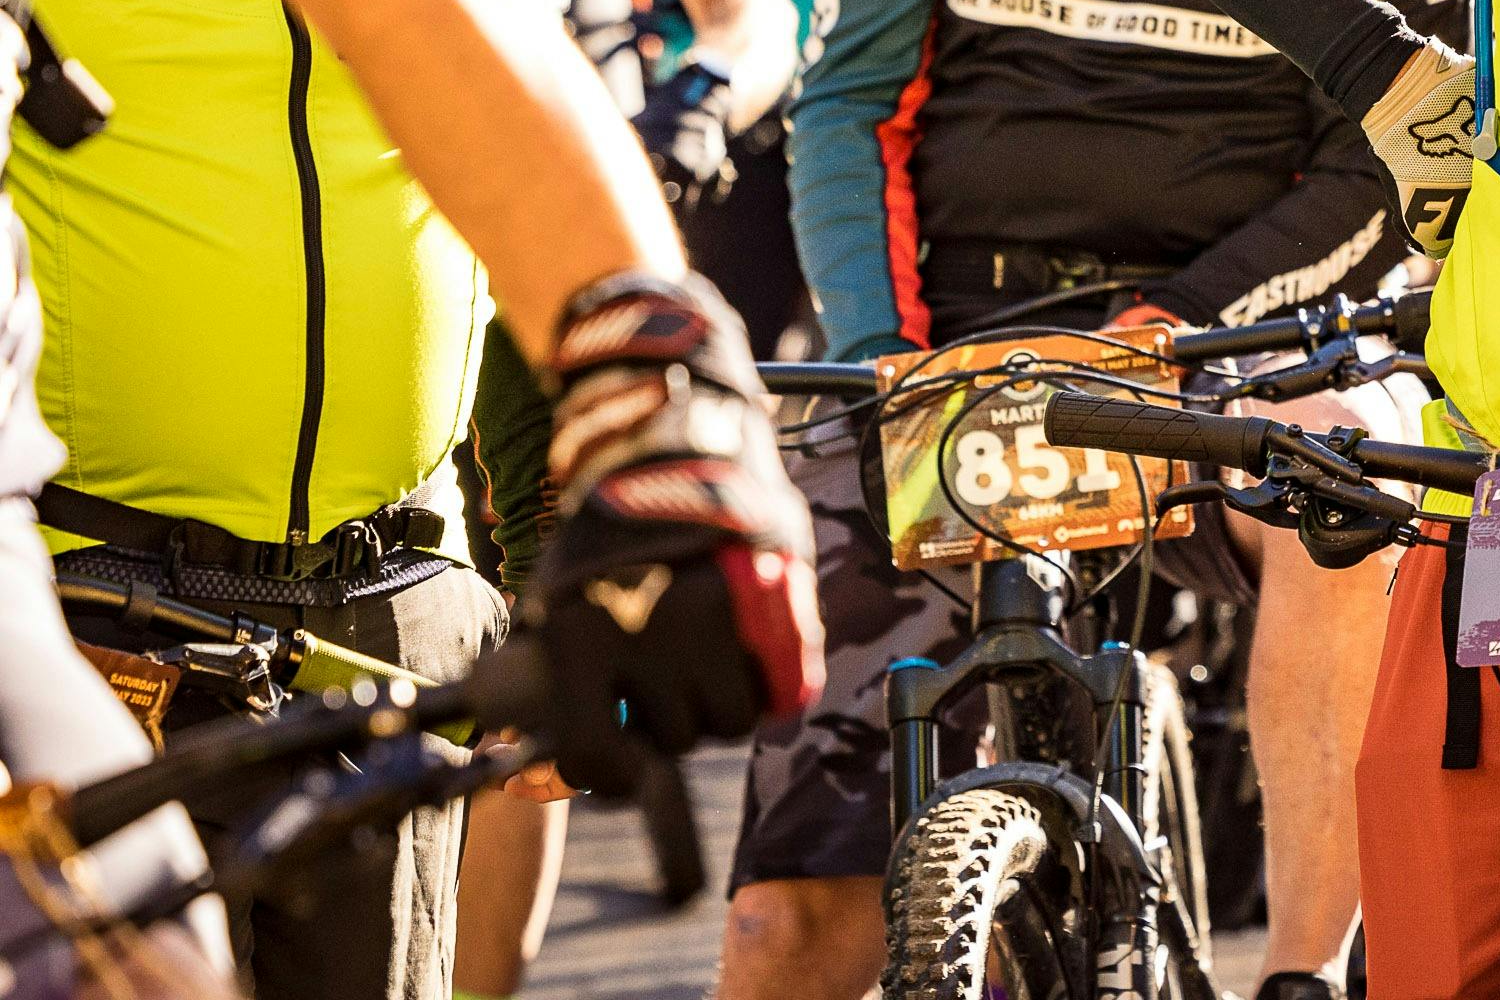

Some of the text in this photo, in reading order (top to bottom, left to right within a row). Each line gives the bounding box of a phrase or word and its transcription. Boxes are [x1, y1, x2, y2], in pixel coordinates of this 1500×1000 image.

[990, 402, 1045, 426] MART
[956, 423, 1121, 506] 851
[110, 673, 159, 692] SATURDAY
